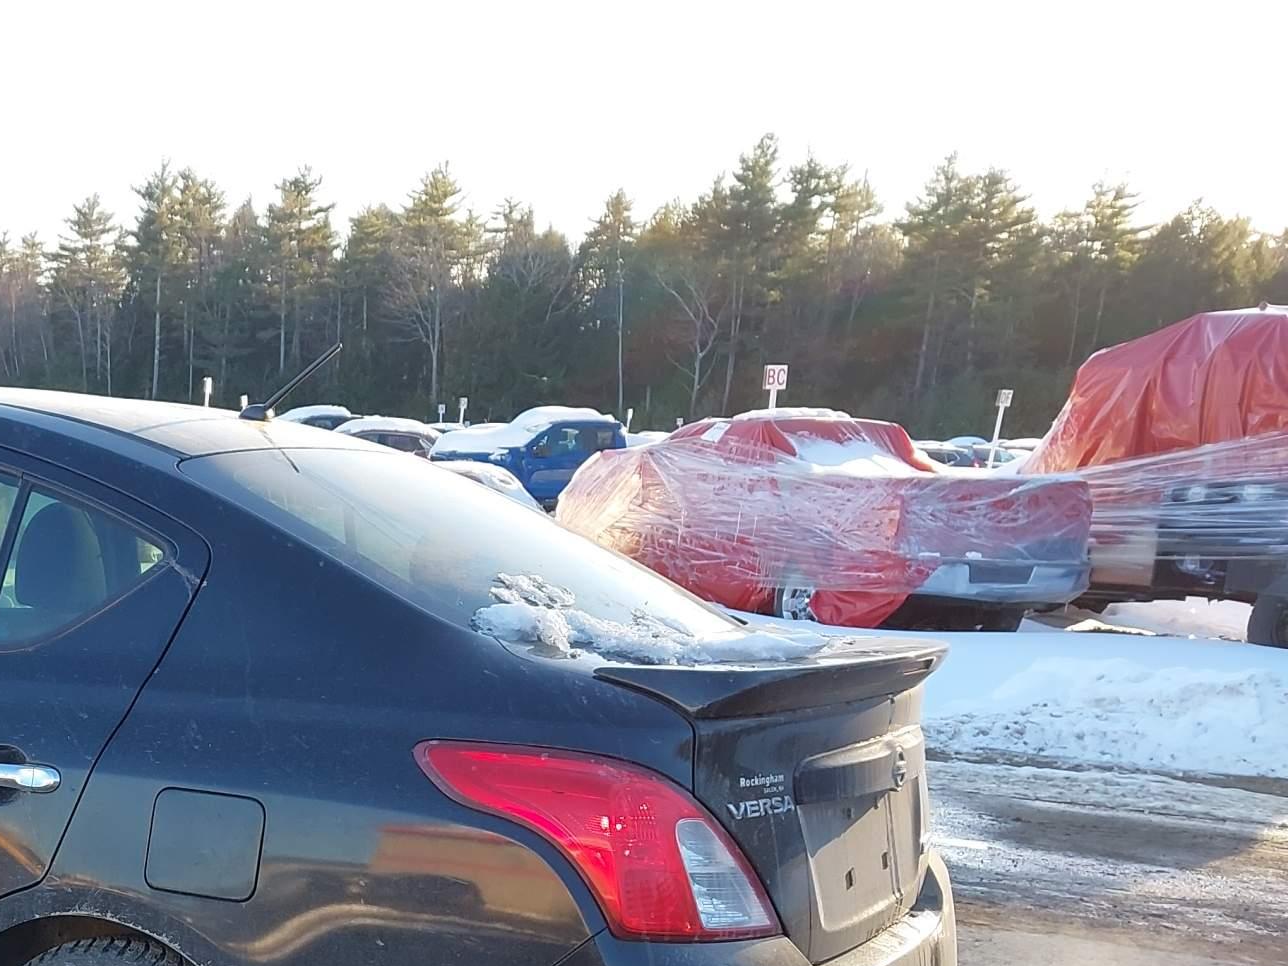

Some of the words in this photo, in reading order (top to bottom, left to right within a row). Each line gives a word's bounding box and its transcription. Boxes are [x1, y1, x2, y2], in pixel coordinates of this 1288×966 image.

[767, 368, 786, 386] BC
[739, 773, 785, 788] Rockingham
[726, 795, 795, 820] VERSA
